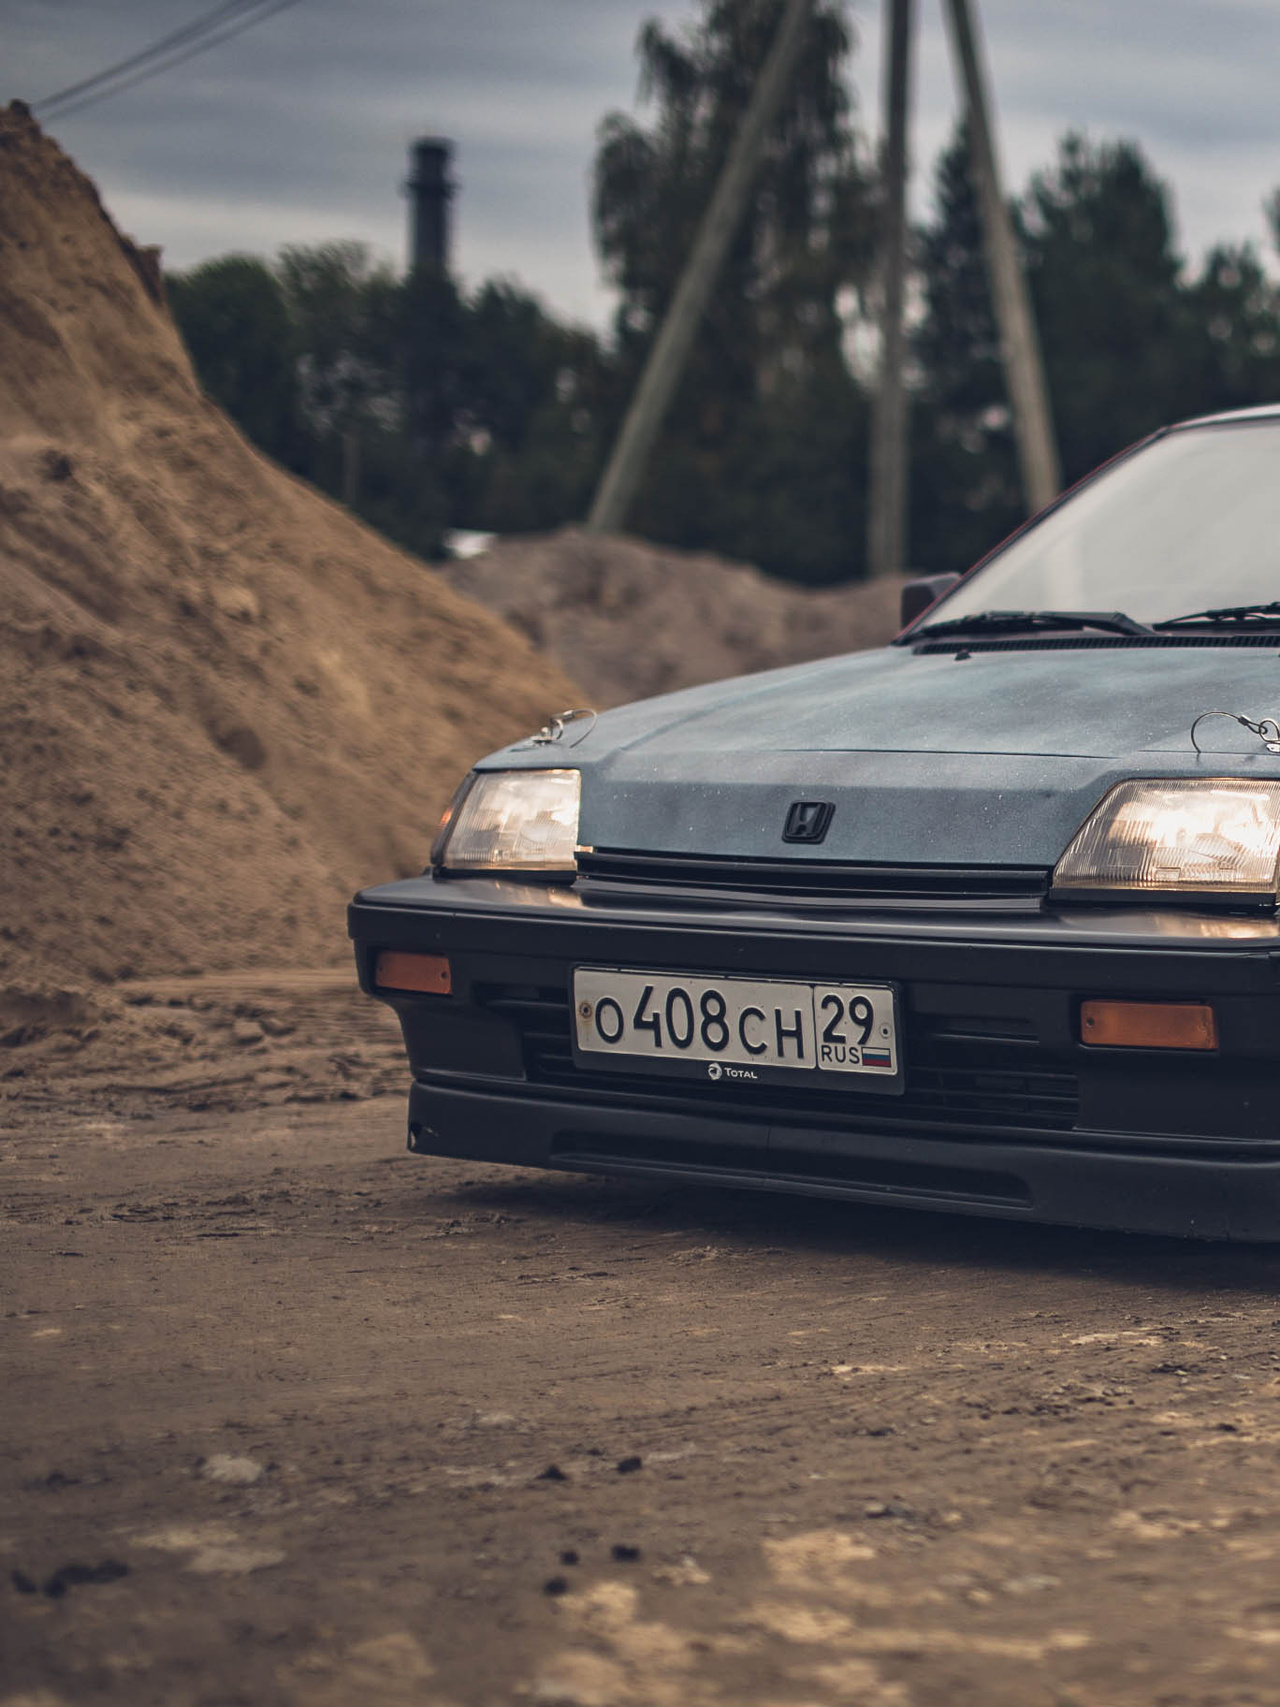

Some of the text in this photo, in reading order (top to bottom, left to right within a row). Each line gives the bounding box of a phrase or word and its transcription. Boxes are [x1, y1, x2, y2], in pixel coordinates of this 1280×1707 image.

[821, 994, 874, 1046] 29
[821, 1044, 860, 1065] RUS
[724, 1066, 758, 1079] TOTAL
